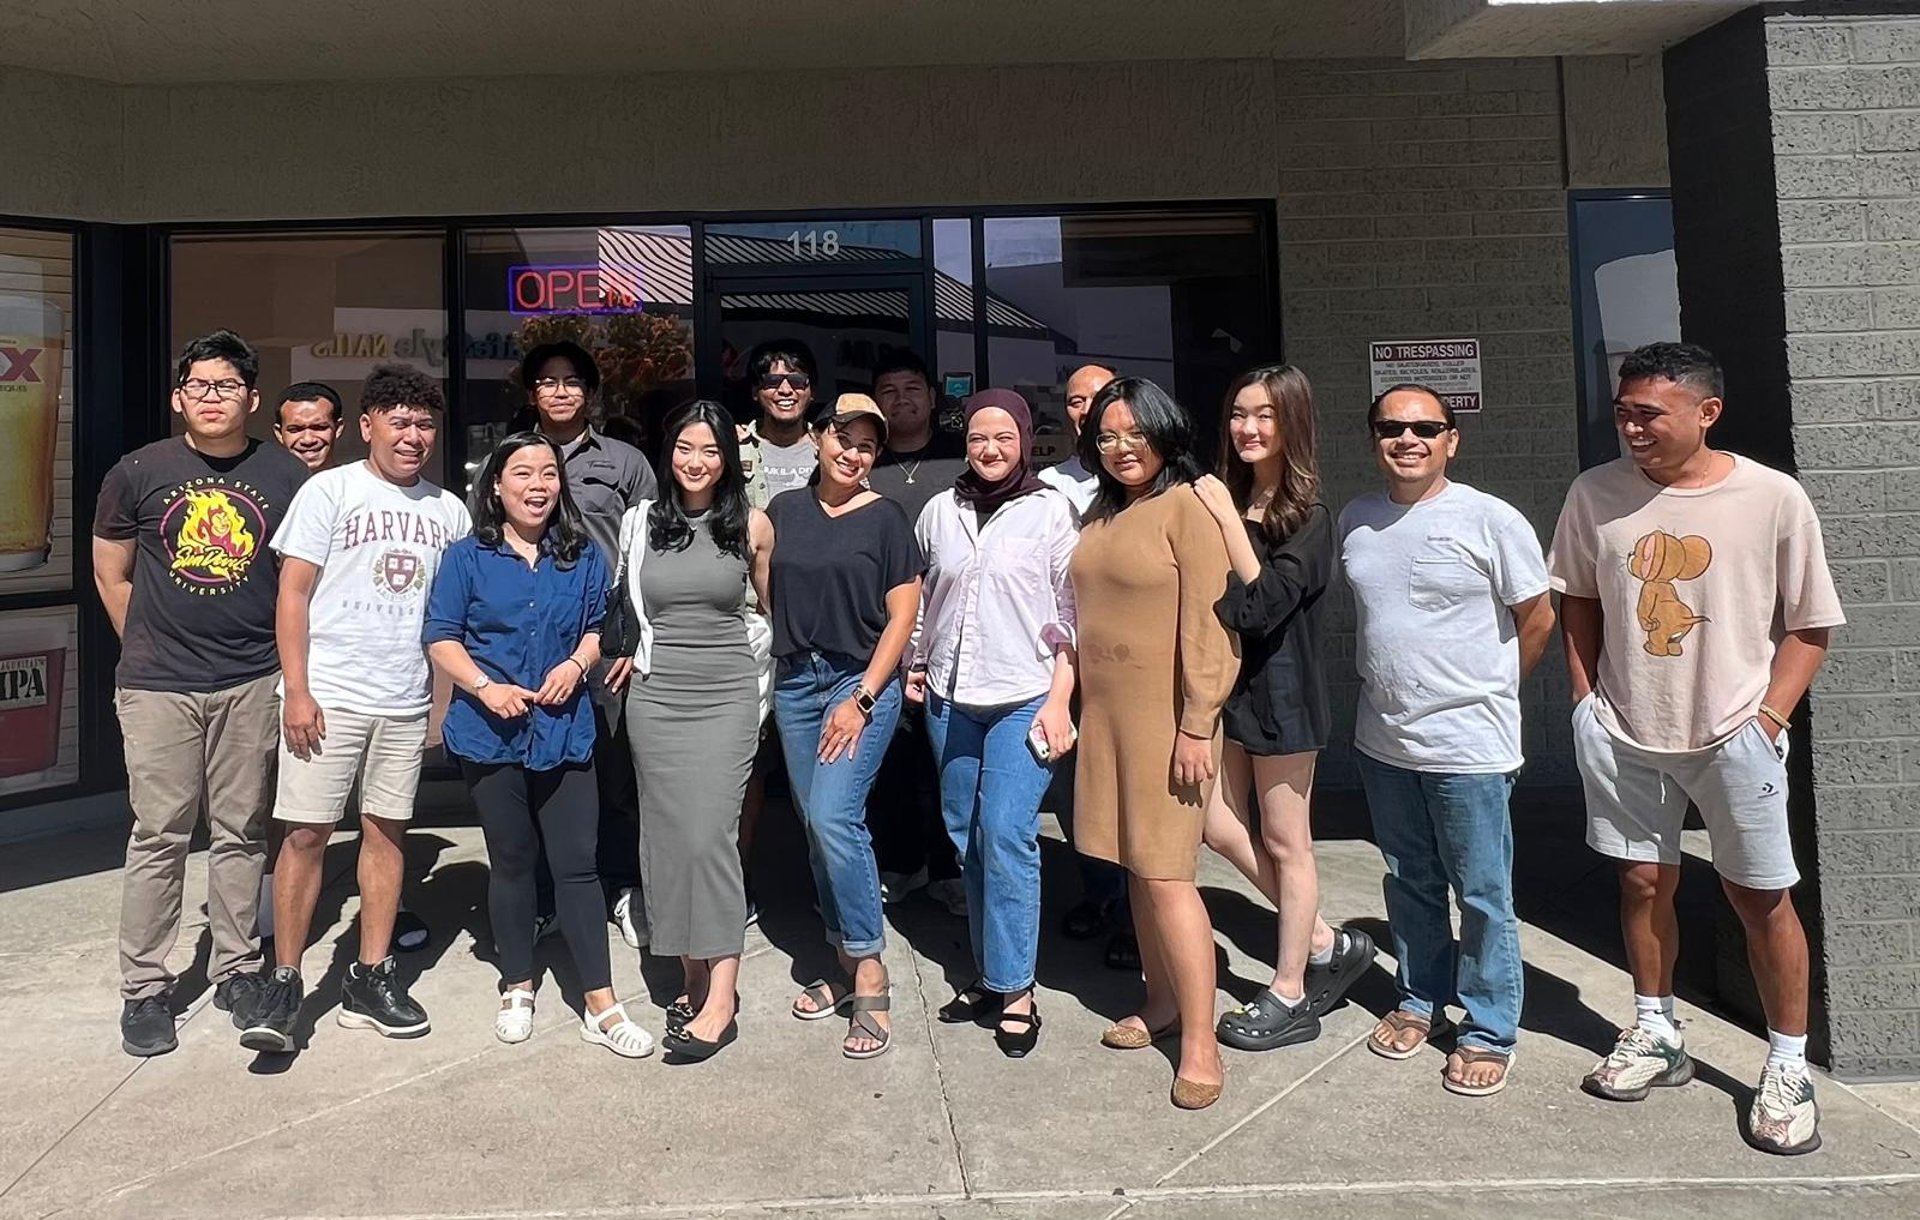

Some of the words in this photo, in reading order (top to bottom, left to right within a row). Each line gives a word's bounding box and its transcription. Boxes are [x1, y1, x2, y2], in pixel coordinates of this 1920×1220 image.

[787, 230, 840, 256] 118
[1375, 347, 1392, 359] NO
[1396, 344, 1474, 358] TRESPASSING
[1032, 446, 1056, 456] ELP
[163, 477, 225, 505] ARIZONA
[234, 481, 270, 510] STATE
[169, 572, 250, 595] UNIVERSITY
